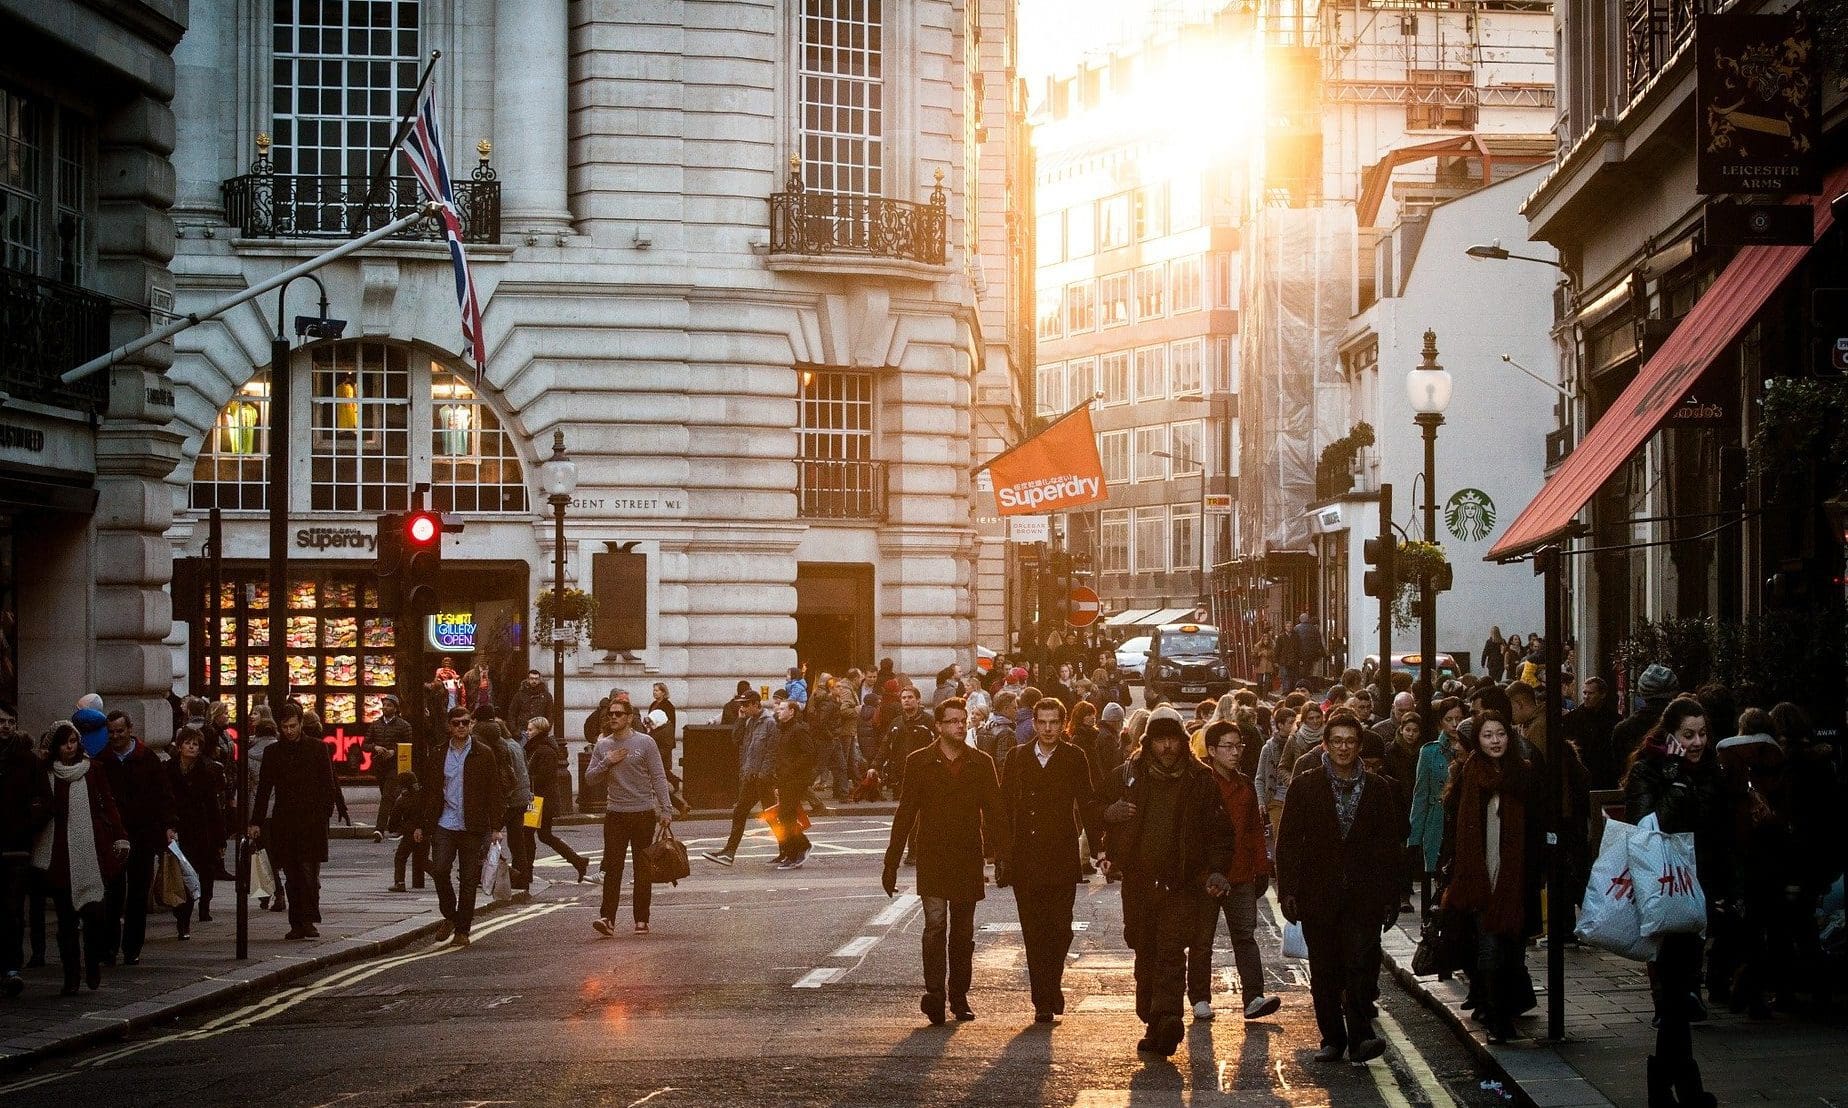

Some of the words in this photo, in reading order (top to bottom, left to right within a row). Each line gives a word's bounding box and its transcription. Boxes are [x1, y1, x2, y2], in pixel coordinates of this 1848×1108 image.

[1722, 165, 1800, 176] LEICESTER
[1742, 179, 1782, 189] ARMS
[999, 475, 1100, 508] Superdry
[615, 500, 657, 508] STREET
[296, 529, 378, 552] Superdry
[1657, 862, 1696, 899] H&M
